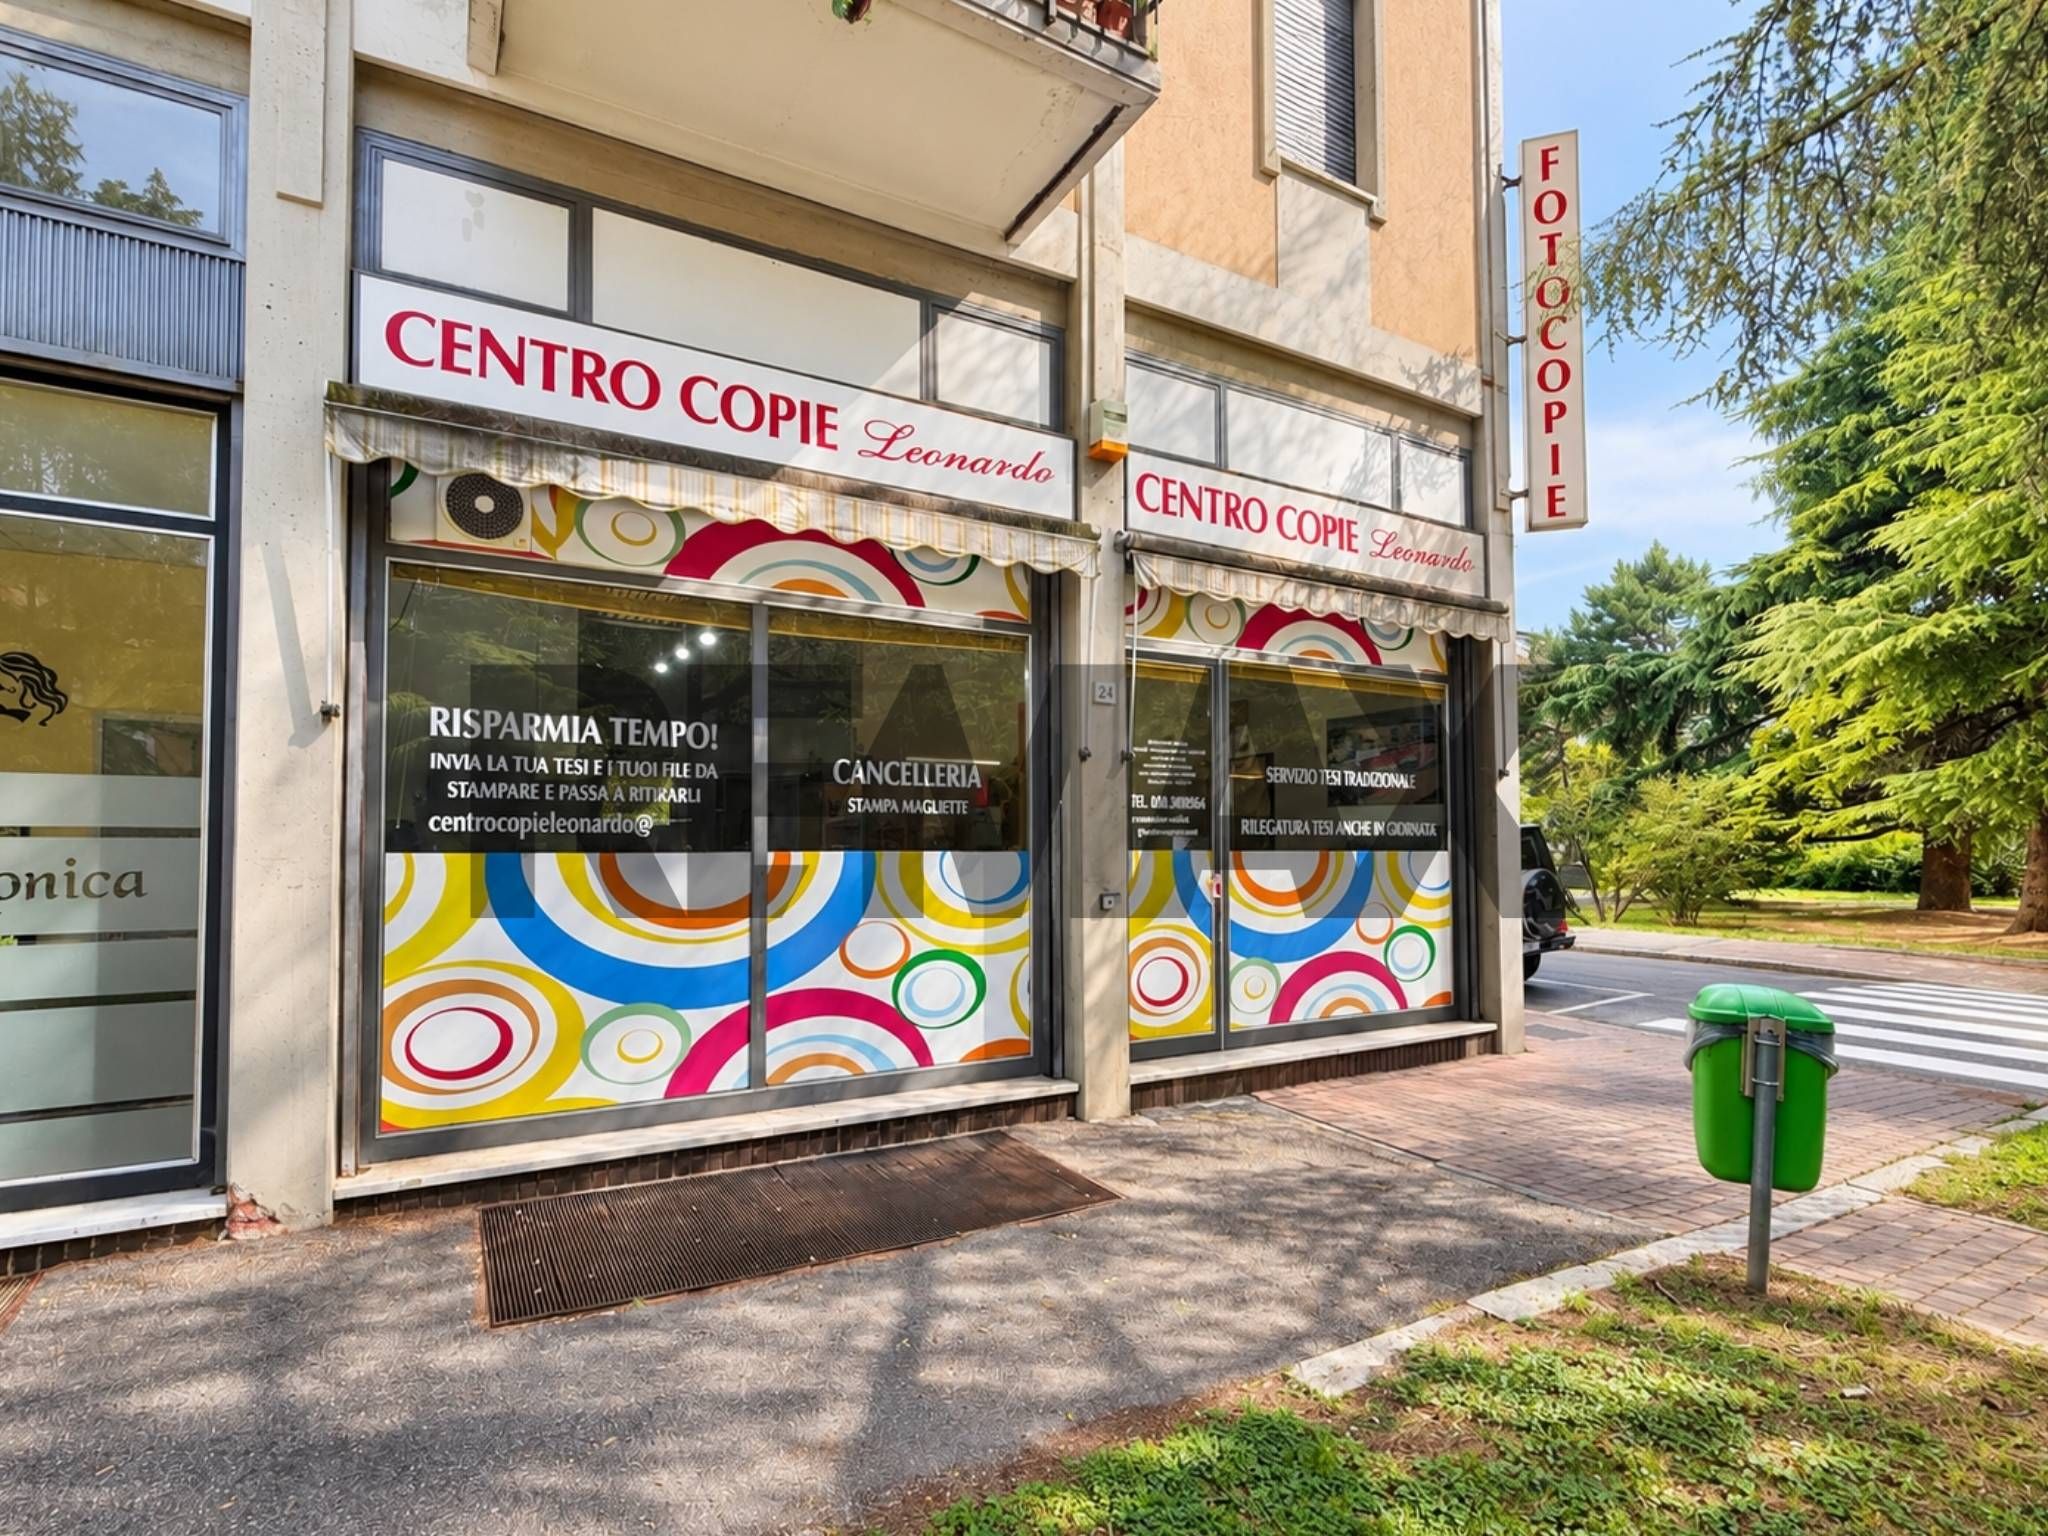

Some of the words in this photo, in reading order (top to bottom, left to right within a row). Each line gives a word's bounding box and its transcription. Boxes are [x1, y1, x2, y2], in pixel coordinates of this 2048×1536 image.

[1533, 145, 1571, 518] FOTOCOPIE
[385, 309, 662, 412] CENTRO
[678, 375, 839, 451] COPIE
[858, 417, 1056, 486] Leonardo
[1135, 472, 1268, 534] CENTRO
[1276, 505, 1360, 555] COPIE
[1369, 528, 1476, 574] Leonardo
[1098, 685, 1113, 699] 24
[429, 706, 603, 745] RISPARMIA
[608, 716, 719, 751] TEMPO!
[430, 753, 482, 771] INVIA
[487, 754, 509, 772] LA
[513, 756, 549, 774] TUA
[553, 757, 589, 776] TESI
[594, 759, 603, 776] E
[617, 760, 658, 778] TUOI
[662, 761, 692, 778] FILE
[695, 762, 719, 780] DA
[832, 758, 982, 788] CANCELLERIA
[1266, 766, 1317, 784] SERVIZIO
[1319, 768, 1341, 786] TESI
[1343, 770, 1416, 790] TRADIZIONALE
[447, 781, 540, 800] STAMPARE
[545, 783, 555, 800] E
[559, 784, 608, 802] PASSA
[612, 786, 626, 802] A
[629, 786, 702, 803] RITIRARLI
[847, 797, 900, 814] STAMPA
[901, 799, 969, 815] MAGLIETTE
[428, 810, 654, 840] centrocopieleonardo@
[1240, 818, 1310, 836] RILEGATURA
[1312, 819, 1334, 836] TESI
[1336, 819, 1372, 837] ANCHE
